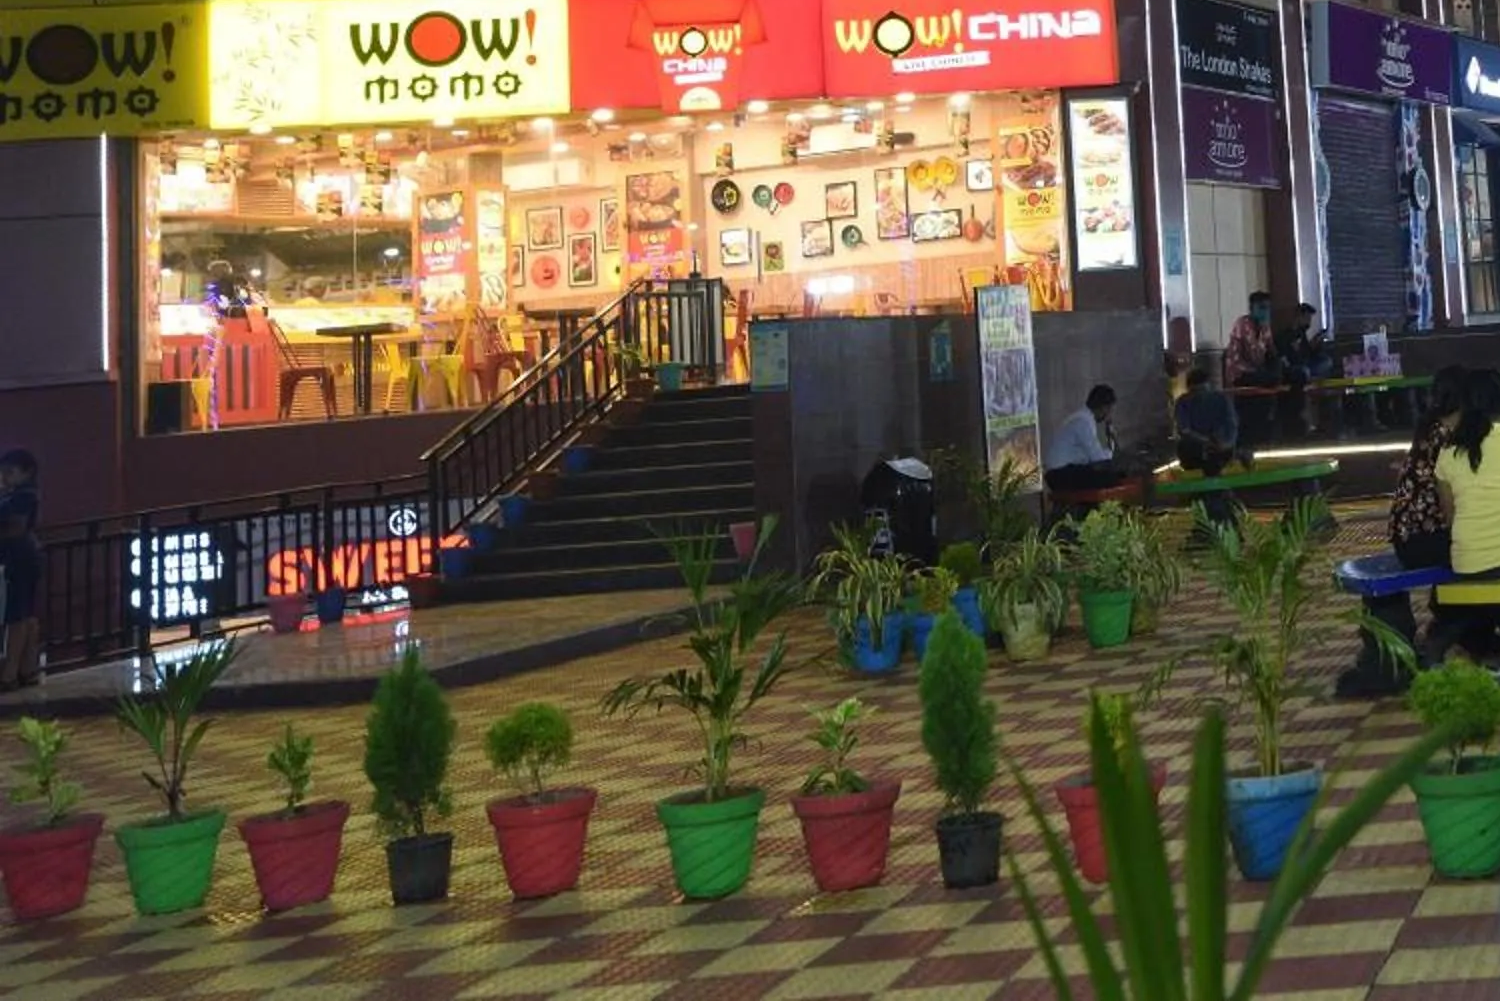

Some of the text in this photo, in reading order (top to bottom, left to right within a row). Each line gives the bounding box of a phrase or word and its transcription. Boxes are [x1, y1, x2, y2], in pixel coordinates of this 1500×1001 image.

[349, 9, 537, 67] WOW!
[653, 22, 743, 60] WOW!
[834, 8, 1101, 59] WOW! CHINA
[662, 56, 728, 75] CHINA
[1181, 45, 1201, 70] The
[1202, 50, 1238, 79] London
[267, 534, 470, 595] SWEE
